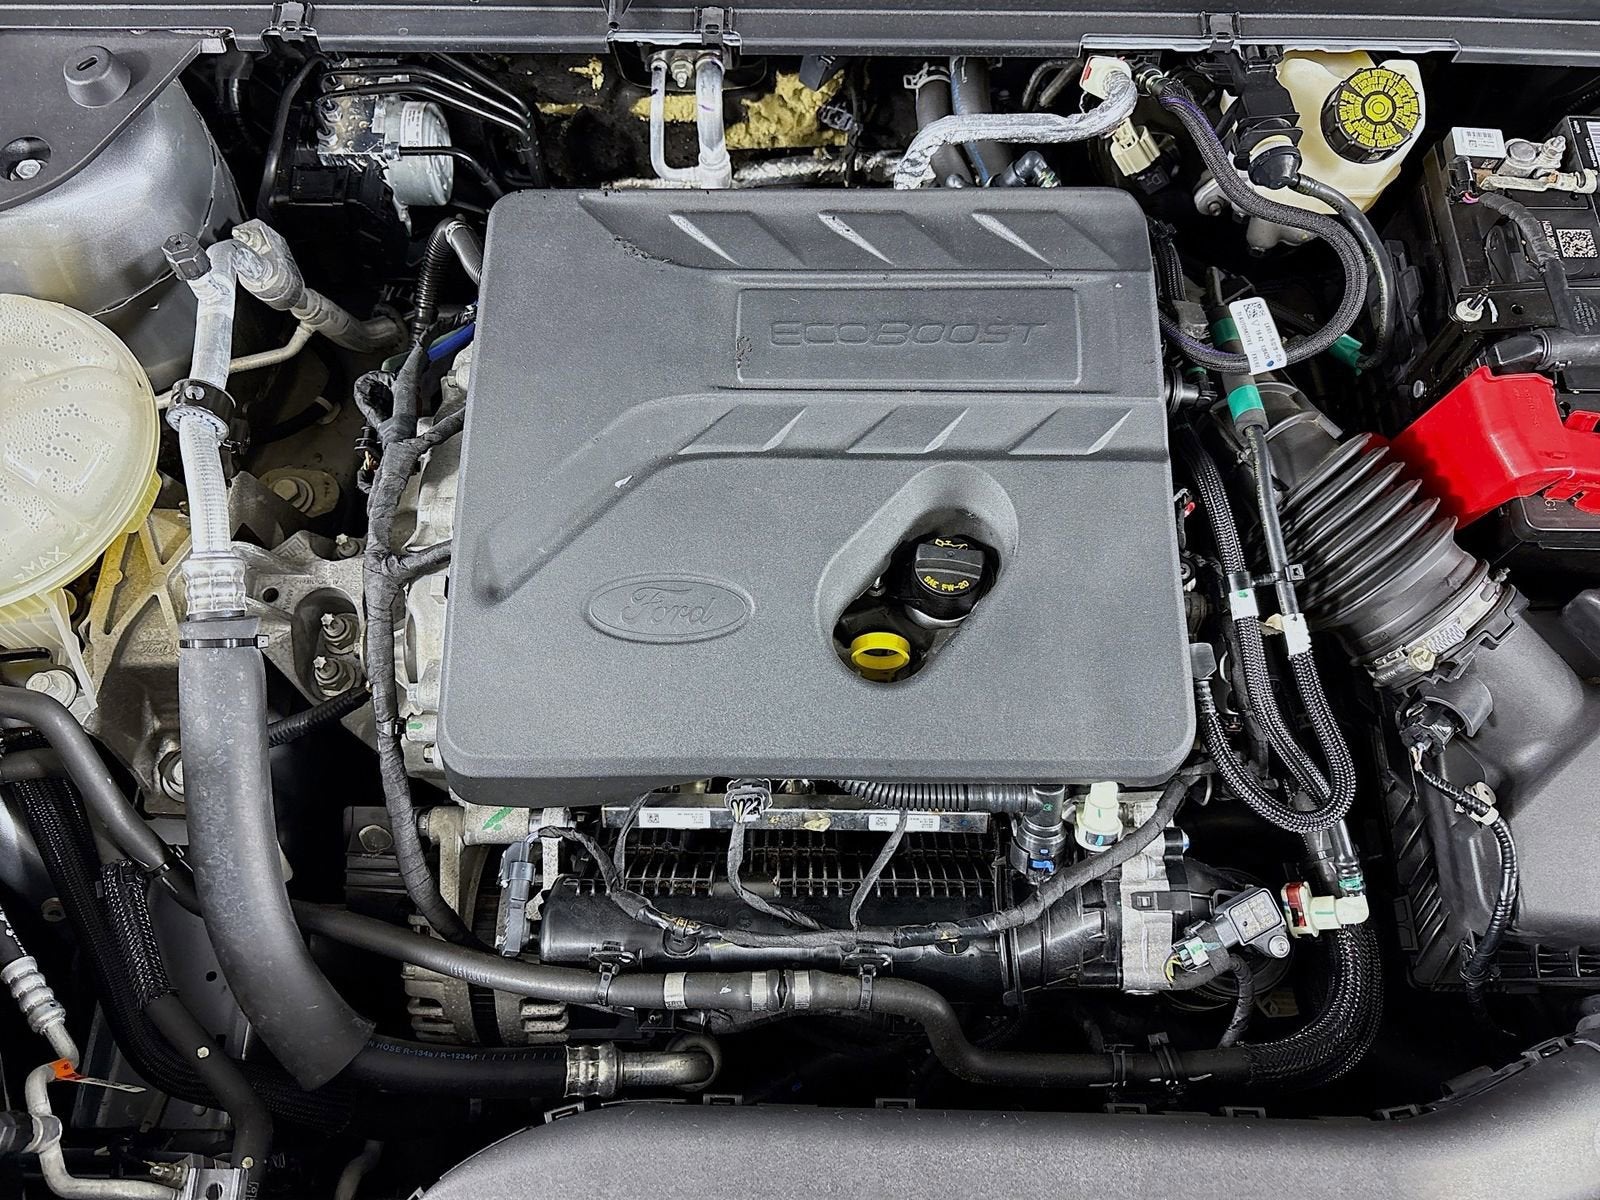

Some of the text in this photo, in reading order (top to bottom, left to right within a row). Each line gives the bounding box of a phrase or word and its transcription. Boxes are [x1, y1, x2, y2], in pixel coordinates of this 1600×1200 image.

[769, 321, 1047, 347] ECOBOOST
[20, 545, 68, 578] MAX
[924, 575, 939, 589] SAE
[620, 586, 715, 626] Ford
[376, 1043, 401, 1053] HOSE
